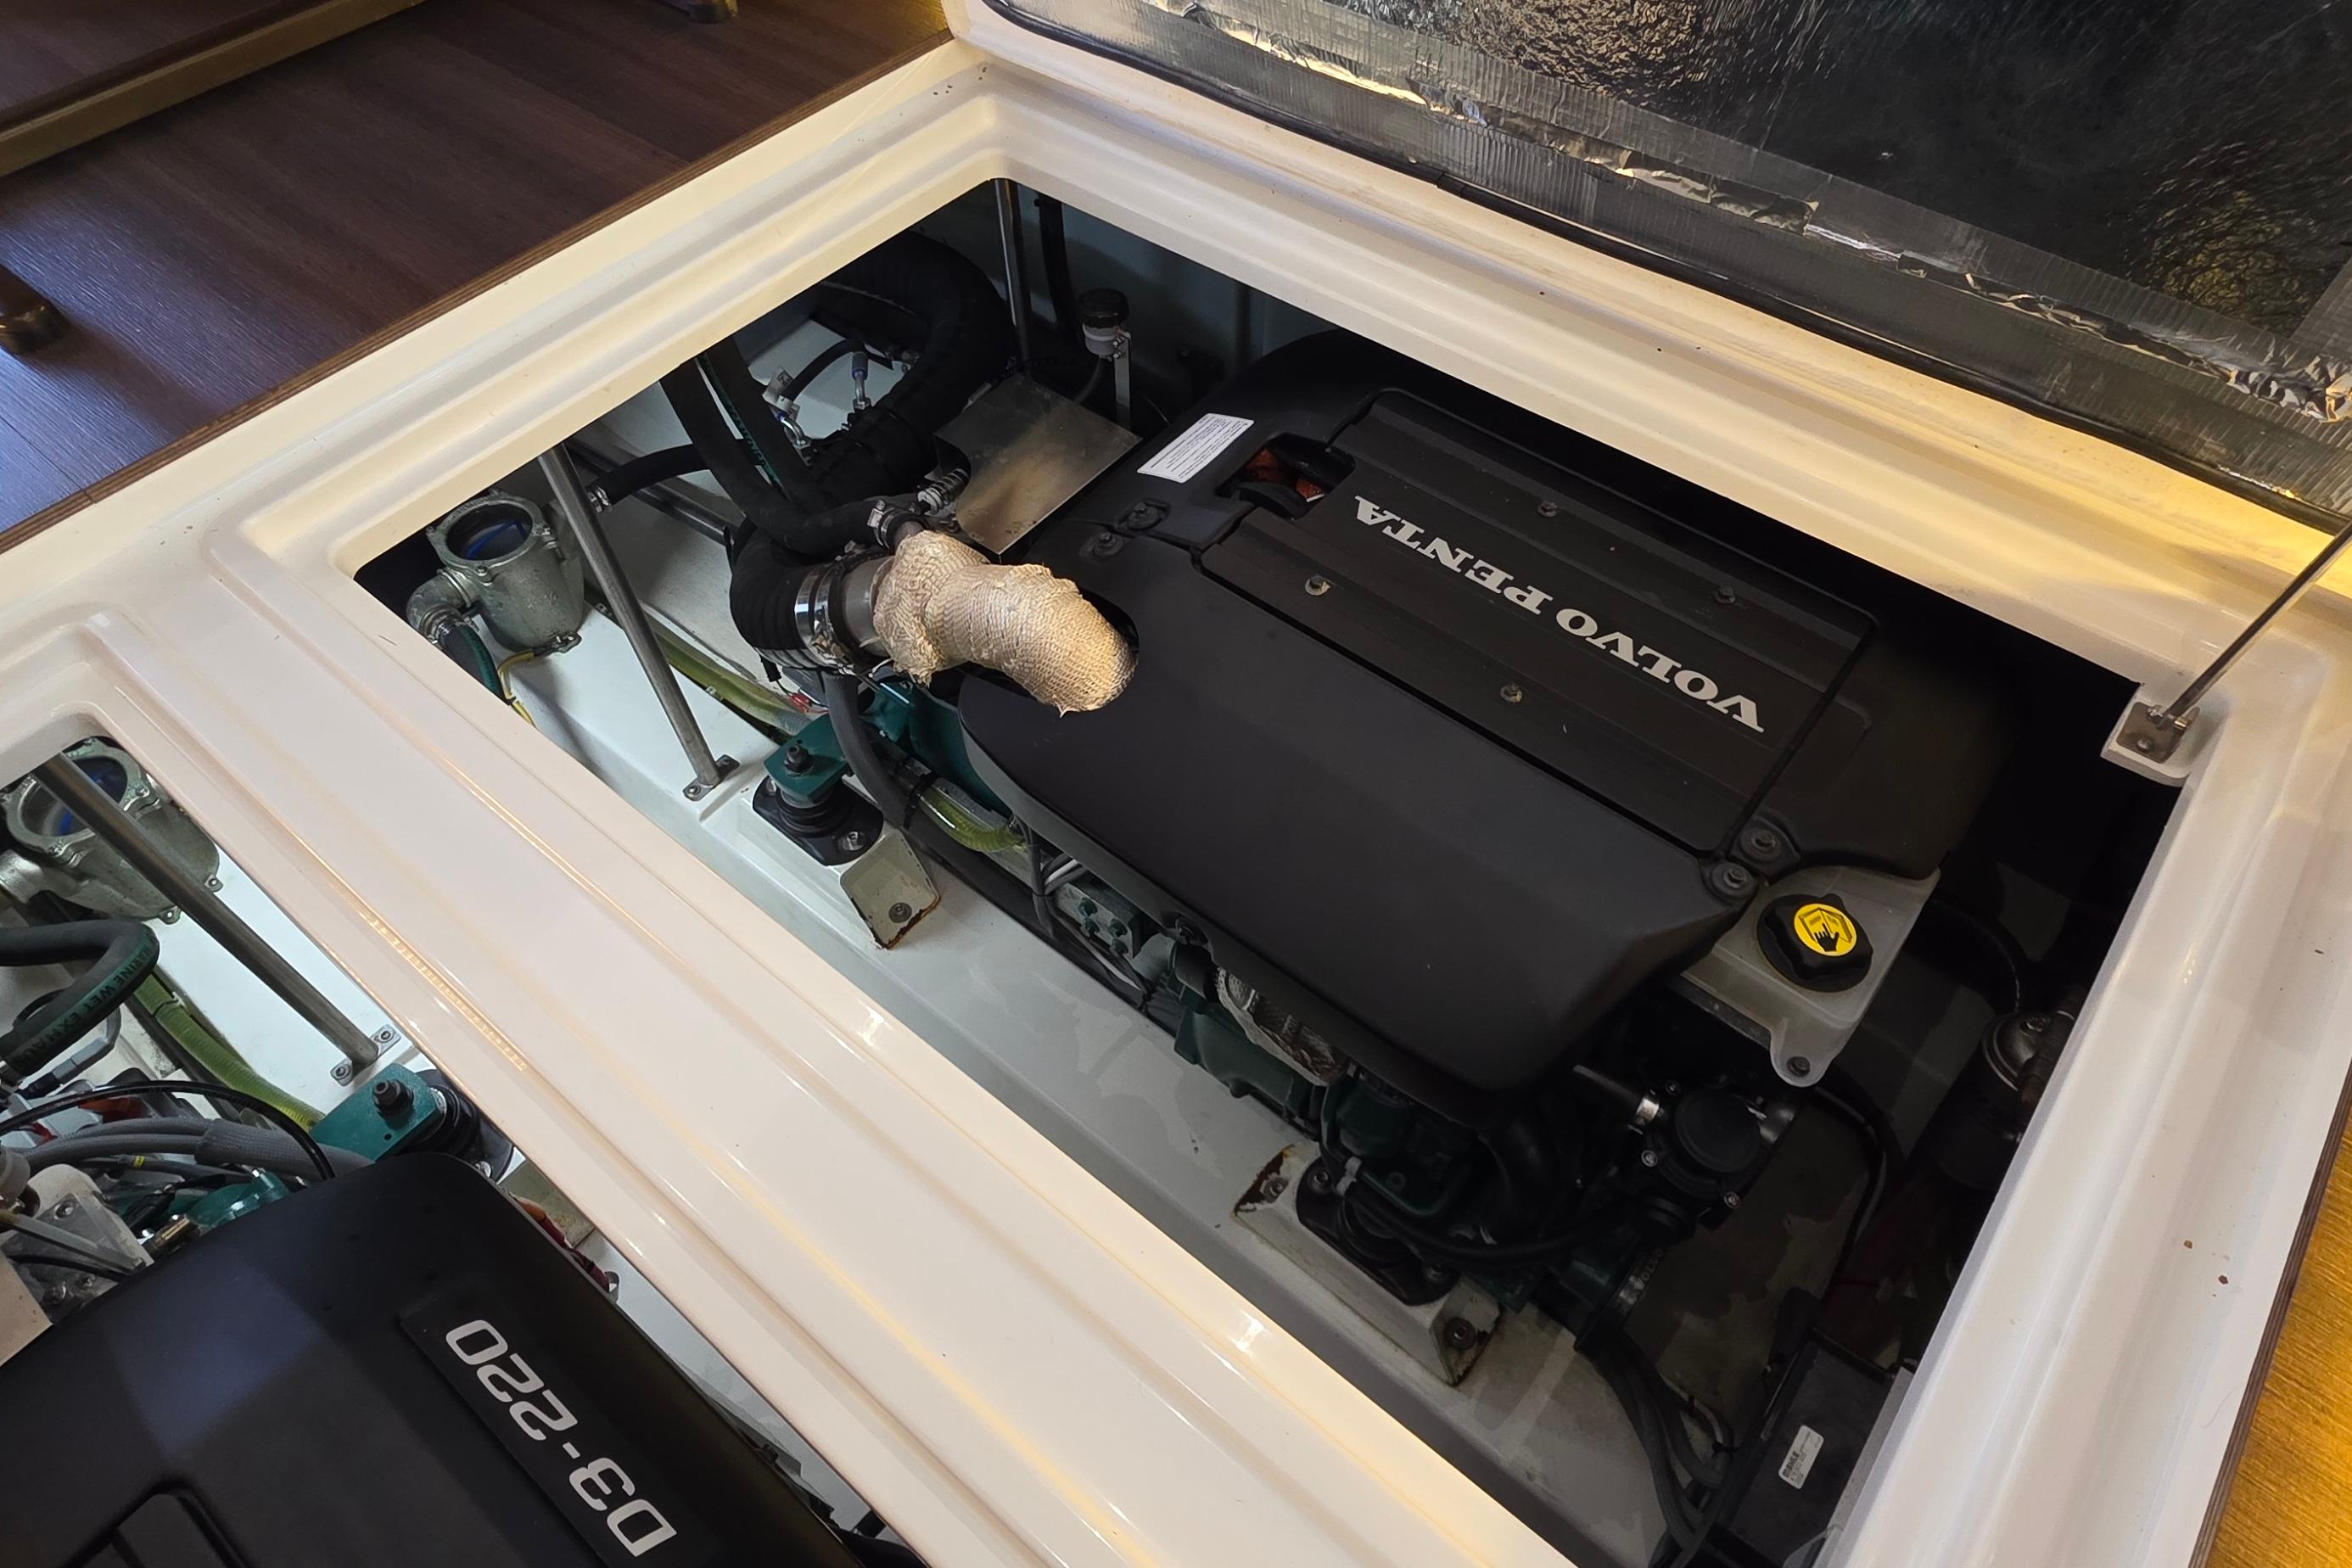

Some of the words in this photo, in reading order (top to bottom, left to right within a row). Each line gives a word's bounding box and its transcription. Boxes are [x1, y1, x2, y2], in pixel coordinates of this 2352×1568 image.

[1353, 495, 1554, 616] PENTA
[1555, 607, 1765, 733] VOLVO
[83, 984, 117, 1013] WET
[113, 944, 152, 986] MARINE
[445, 1319, 677, 1557] D3-220
